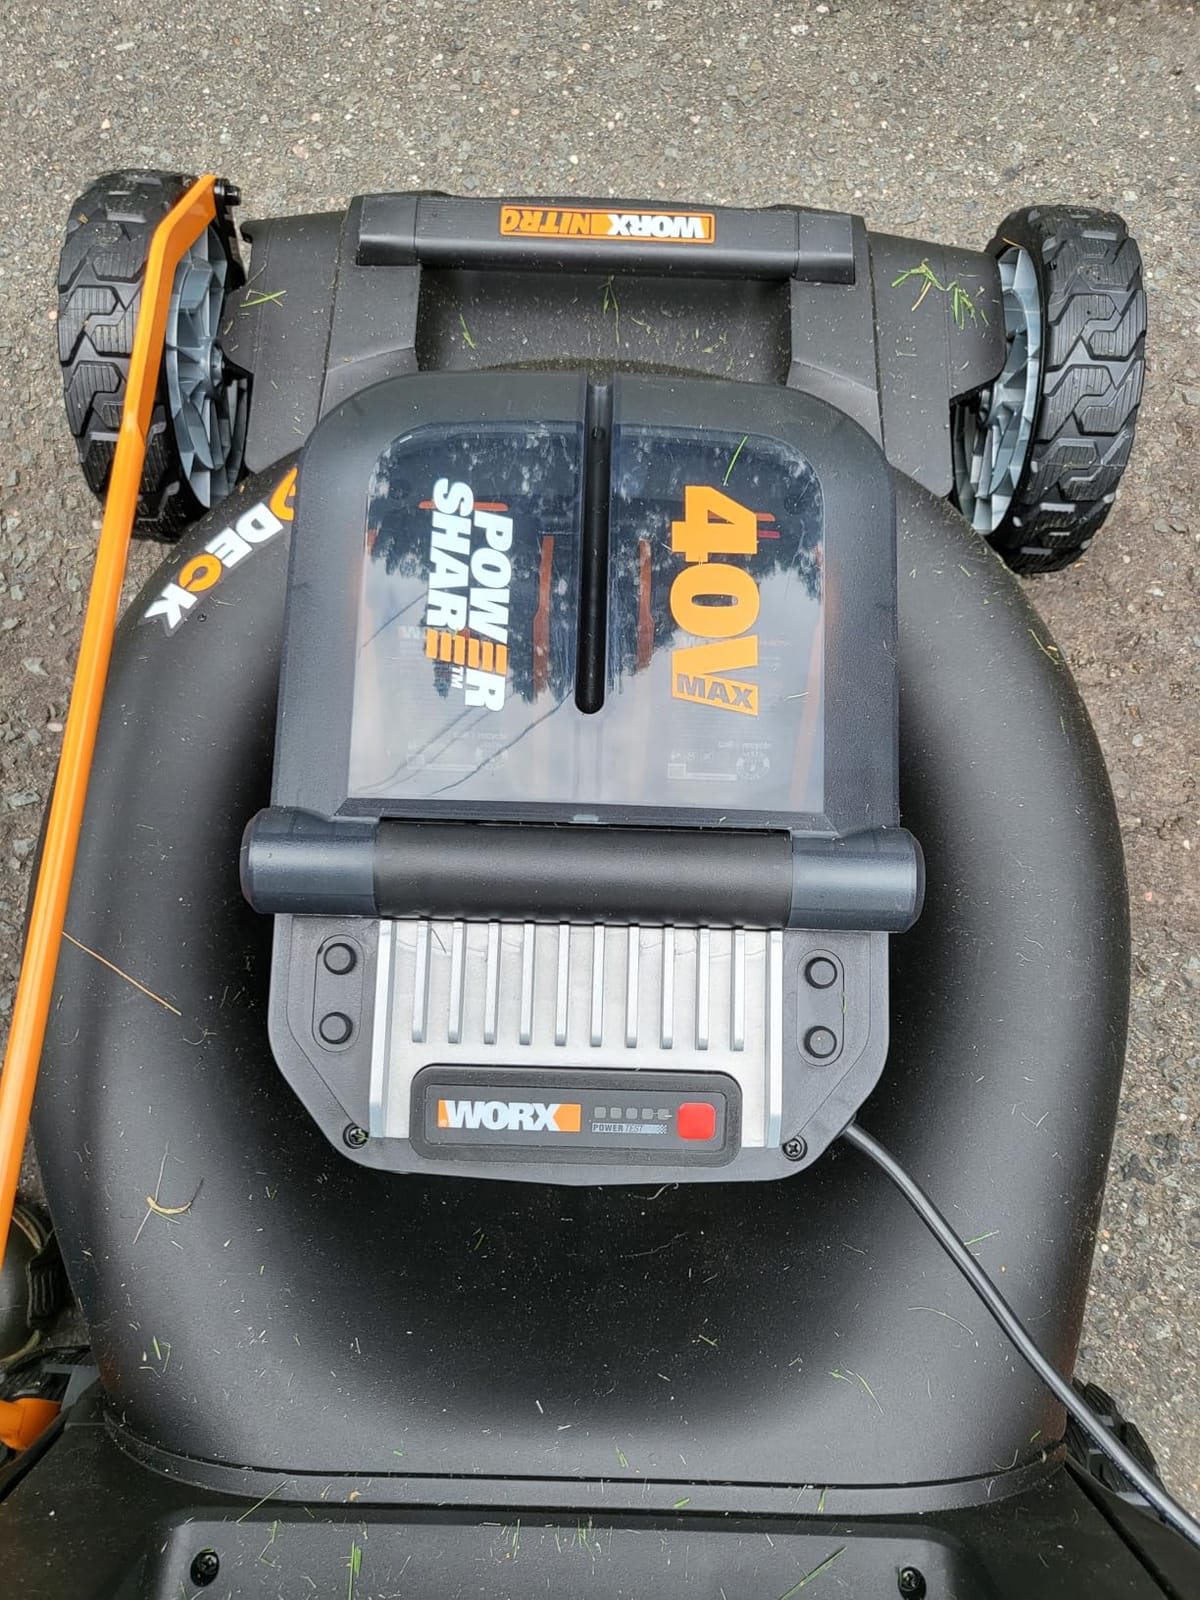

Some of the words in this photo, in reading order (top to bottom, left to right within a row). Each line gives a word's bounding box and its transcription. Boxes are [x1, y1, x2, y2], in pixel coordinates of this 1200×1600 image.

[503, 210, 589, 235] NITRO
[608, 214, 705, 239] WORX
[425, 477, 474, 665] SHARE
[465, 509, 513, 713] POWER
[670, 485, 760, 716] 40V
[677, 674, 753, 708] MAX
[446, 1100, 560, 1131] WORX
